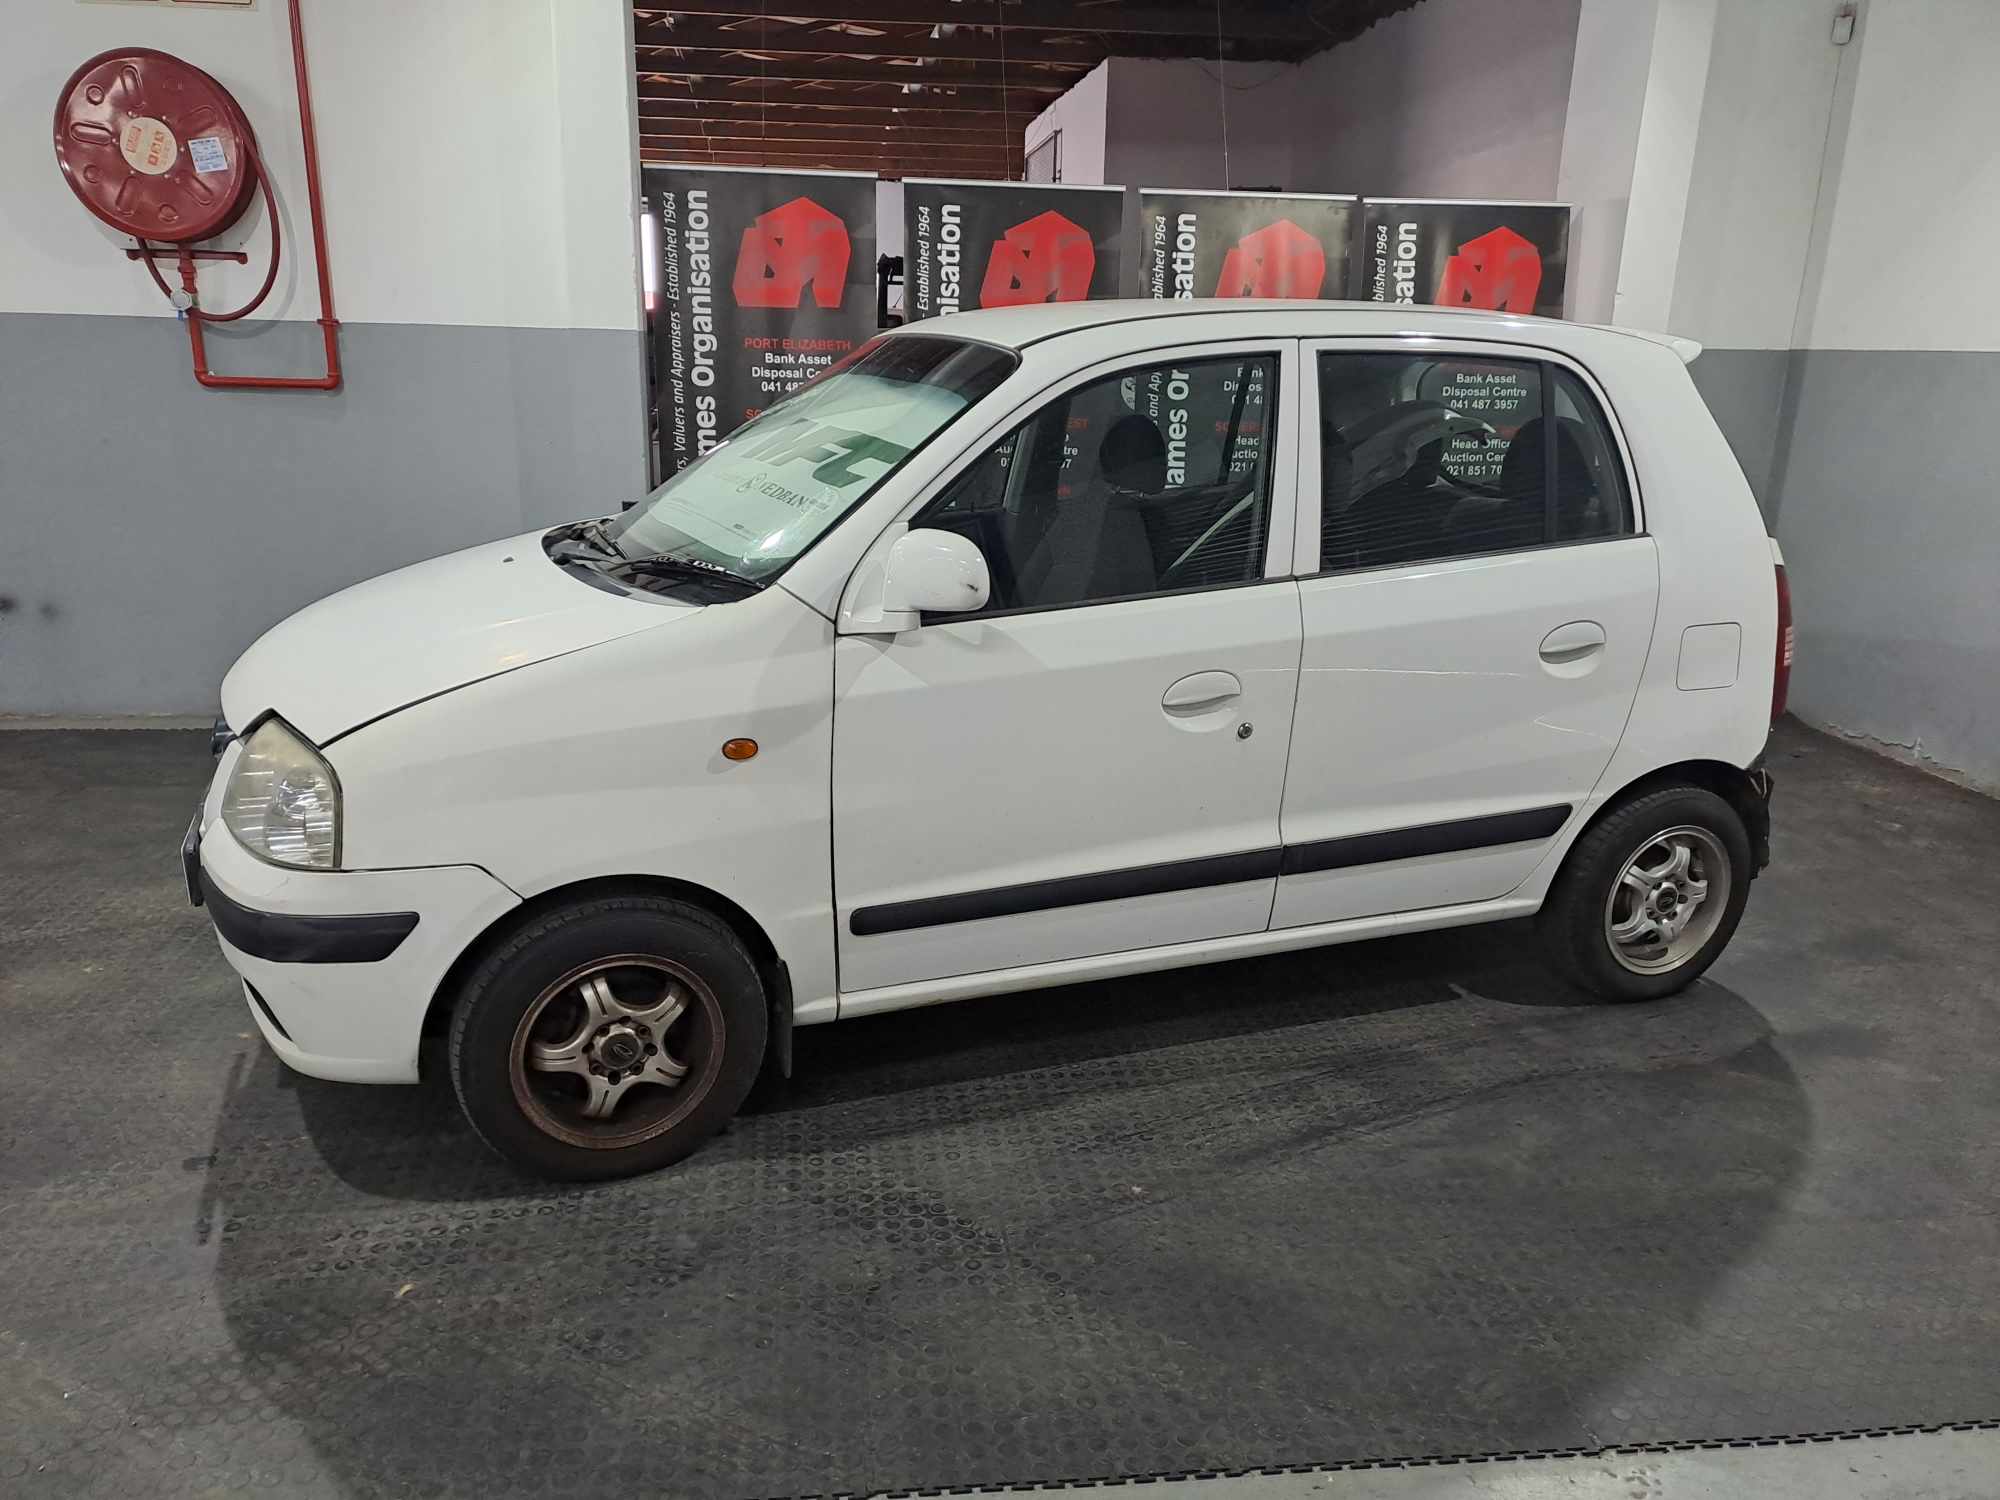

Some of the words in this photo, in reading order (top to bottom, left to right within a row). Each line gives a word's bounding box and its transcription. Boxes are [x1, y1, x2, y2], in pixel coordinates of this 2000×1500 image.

[662, 191, 676, 224] 1964
[918, 206, 930, 237] 1964
[1154, 215, 1167, 246] 1964
[1376, 224, 1388, 255] 1964
[663, 226, 680, 300] Established
[916, 239, 929, 311] Established
[669, 311, 685, 378] Appraisers
[744, 338, 777, 349] PORT
[782, 338, 851, 350] ELIZABETH
[765, 352, 795, 364] Bank
[798, 353, 833, 365] Asset
[751, 366, 803, 380] Disposal
[1456, 373, 1483, 384] Bank
[1485, 373, 1517, 384] Asset
[670, 379, 684, 403] and
[761, 382, 781, 392] 041
[1442, 386, 1490, 398] Disposal
[1492, 387, 1528, 397] Centre
[1147, 393, 1159, 417] and
[1450, 399, 1469, 409] 041
[1471, 399, 1491, 409] 487
[1494, 399, 1519, 410] 3957
[672, 407, 686, 451] Valuers
[1451, 439, 1479, 449] Head
[1441, 451, 1483, 462] Auction
[1467, 465, 1486, 475] 851
[758, 480, 813, 514] NEDBAN
